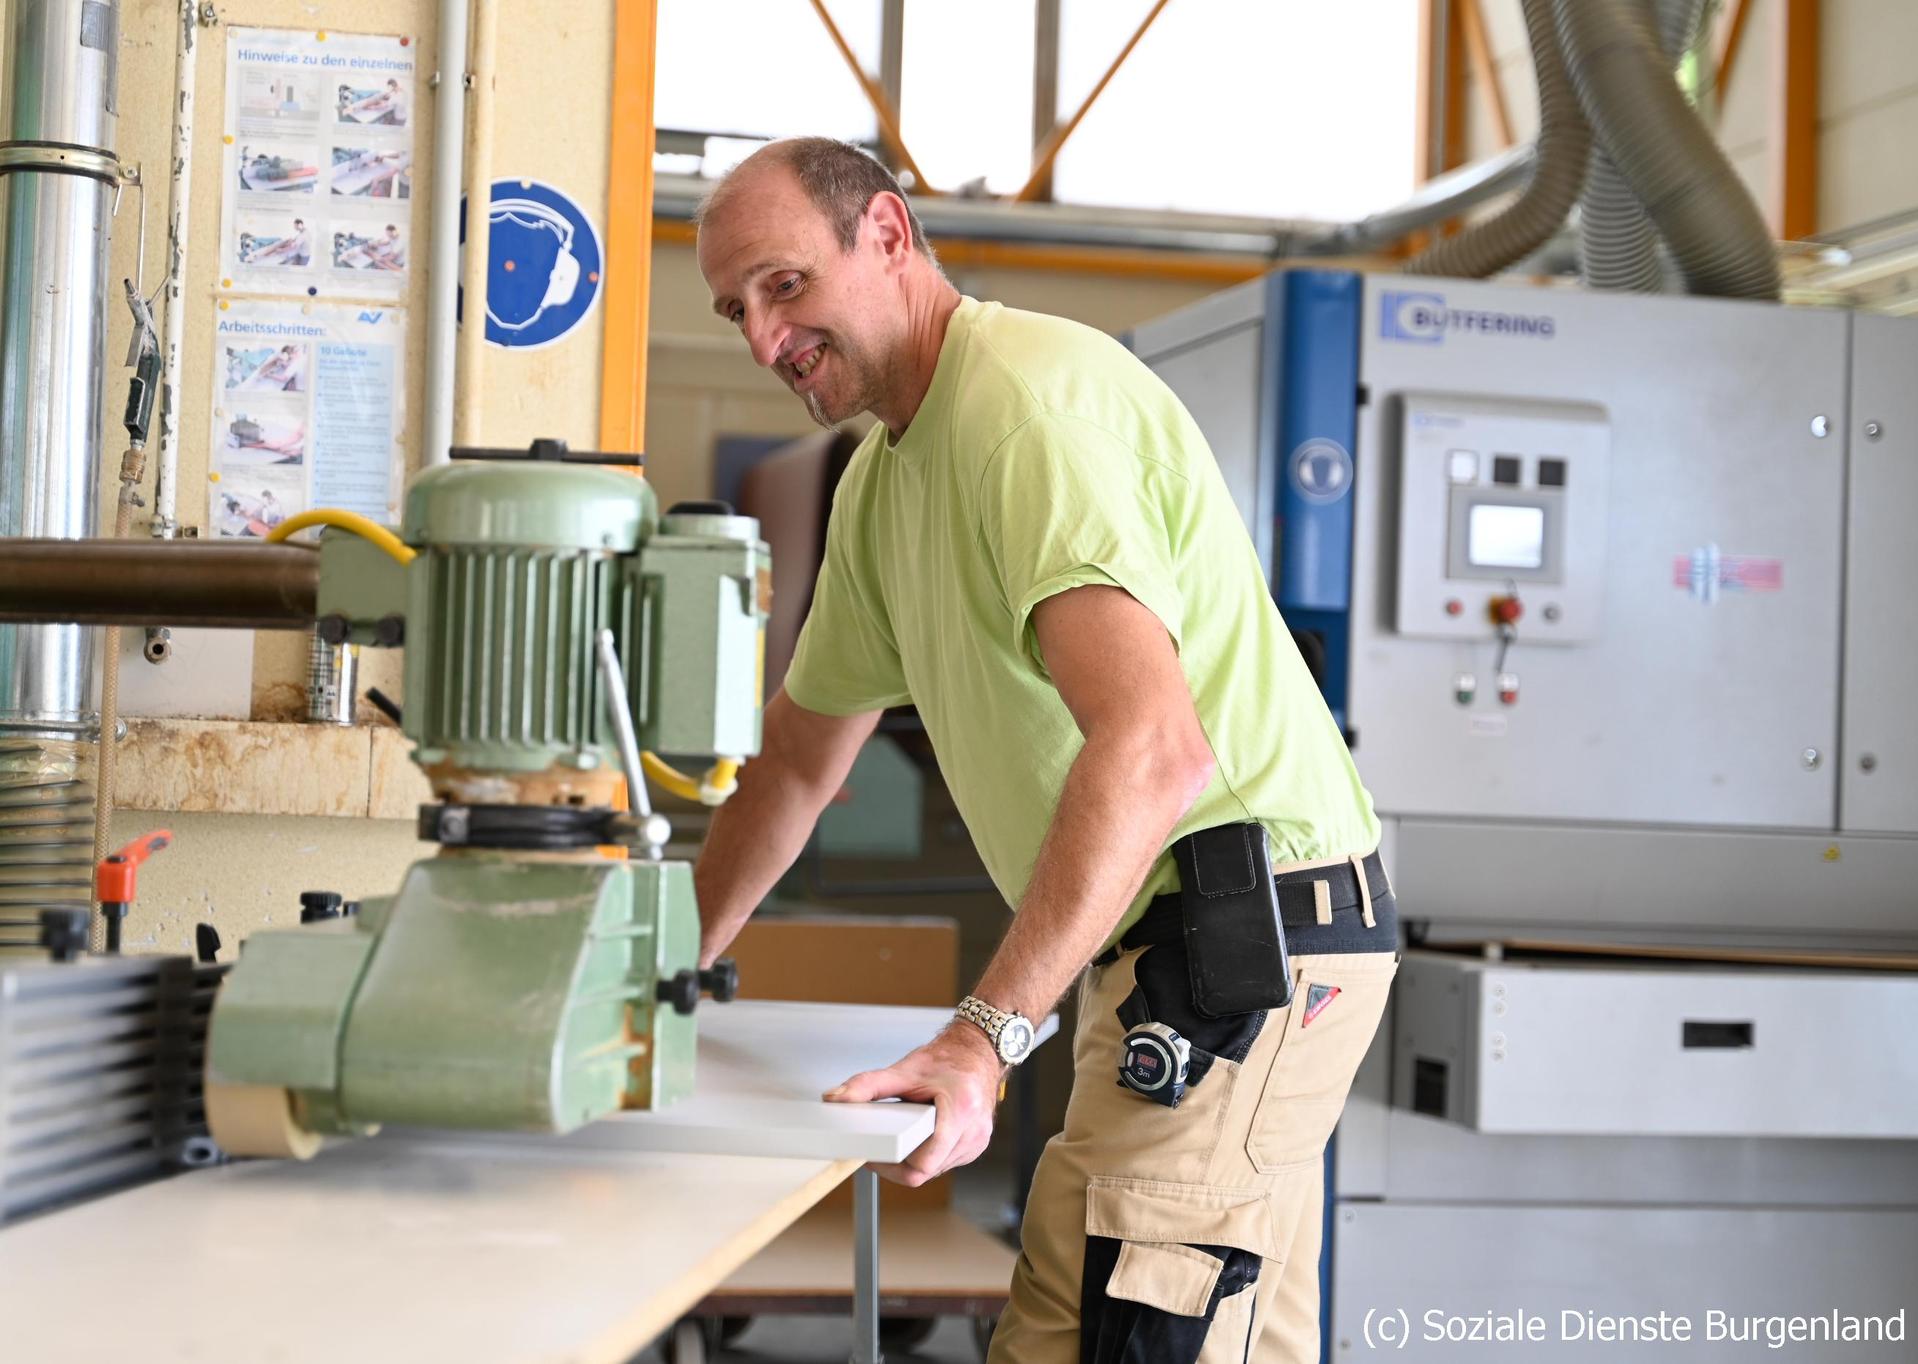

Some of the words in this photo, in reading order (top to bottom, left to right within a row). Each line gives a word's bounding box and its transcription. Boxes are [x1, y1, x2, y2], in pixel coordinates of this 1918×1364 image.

[237, 49, 299, 64] Hinweise
[302, 54, 319, 66] zu
[321, 53, 347, 67] den
[350, 56, 414, 71] einzelnen
[218, 319, 327, 337] Arbeitsschritten:
[1137, 1067, 1151, 1079] 3m
